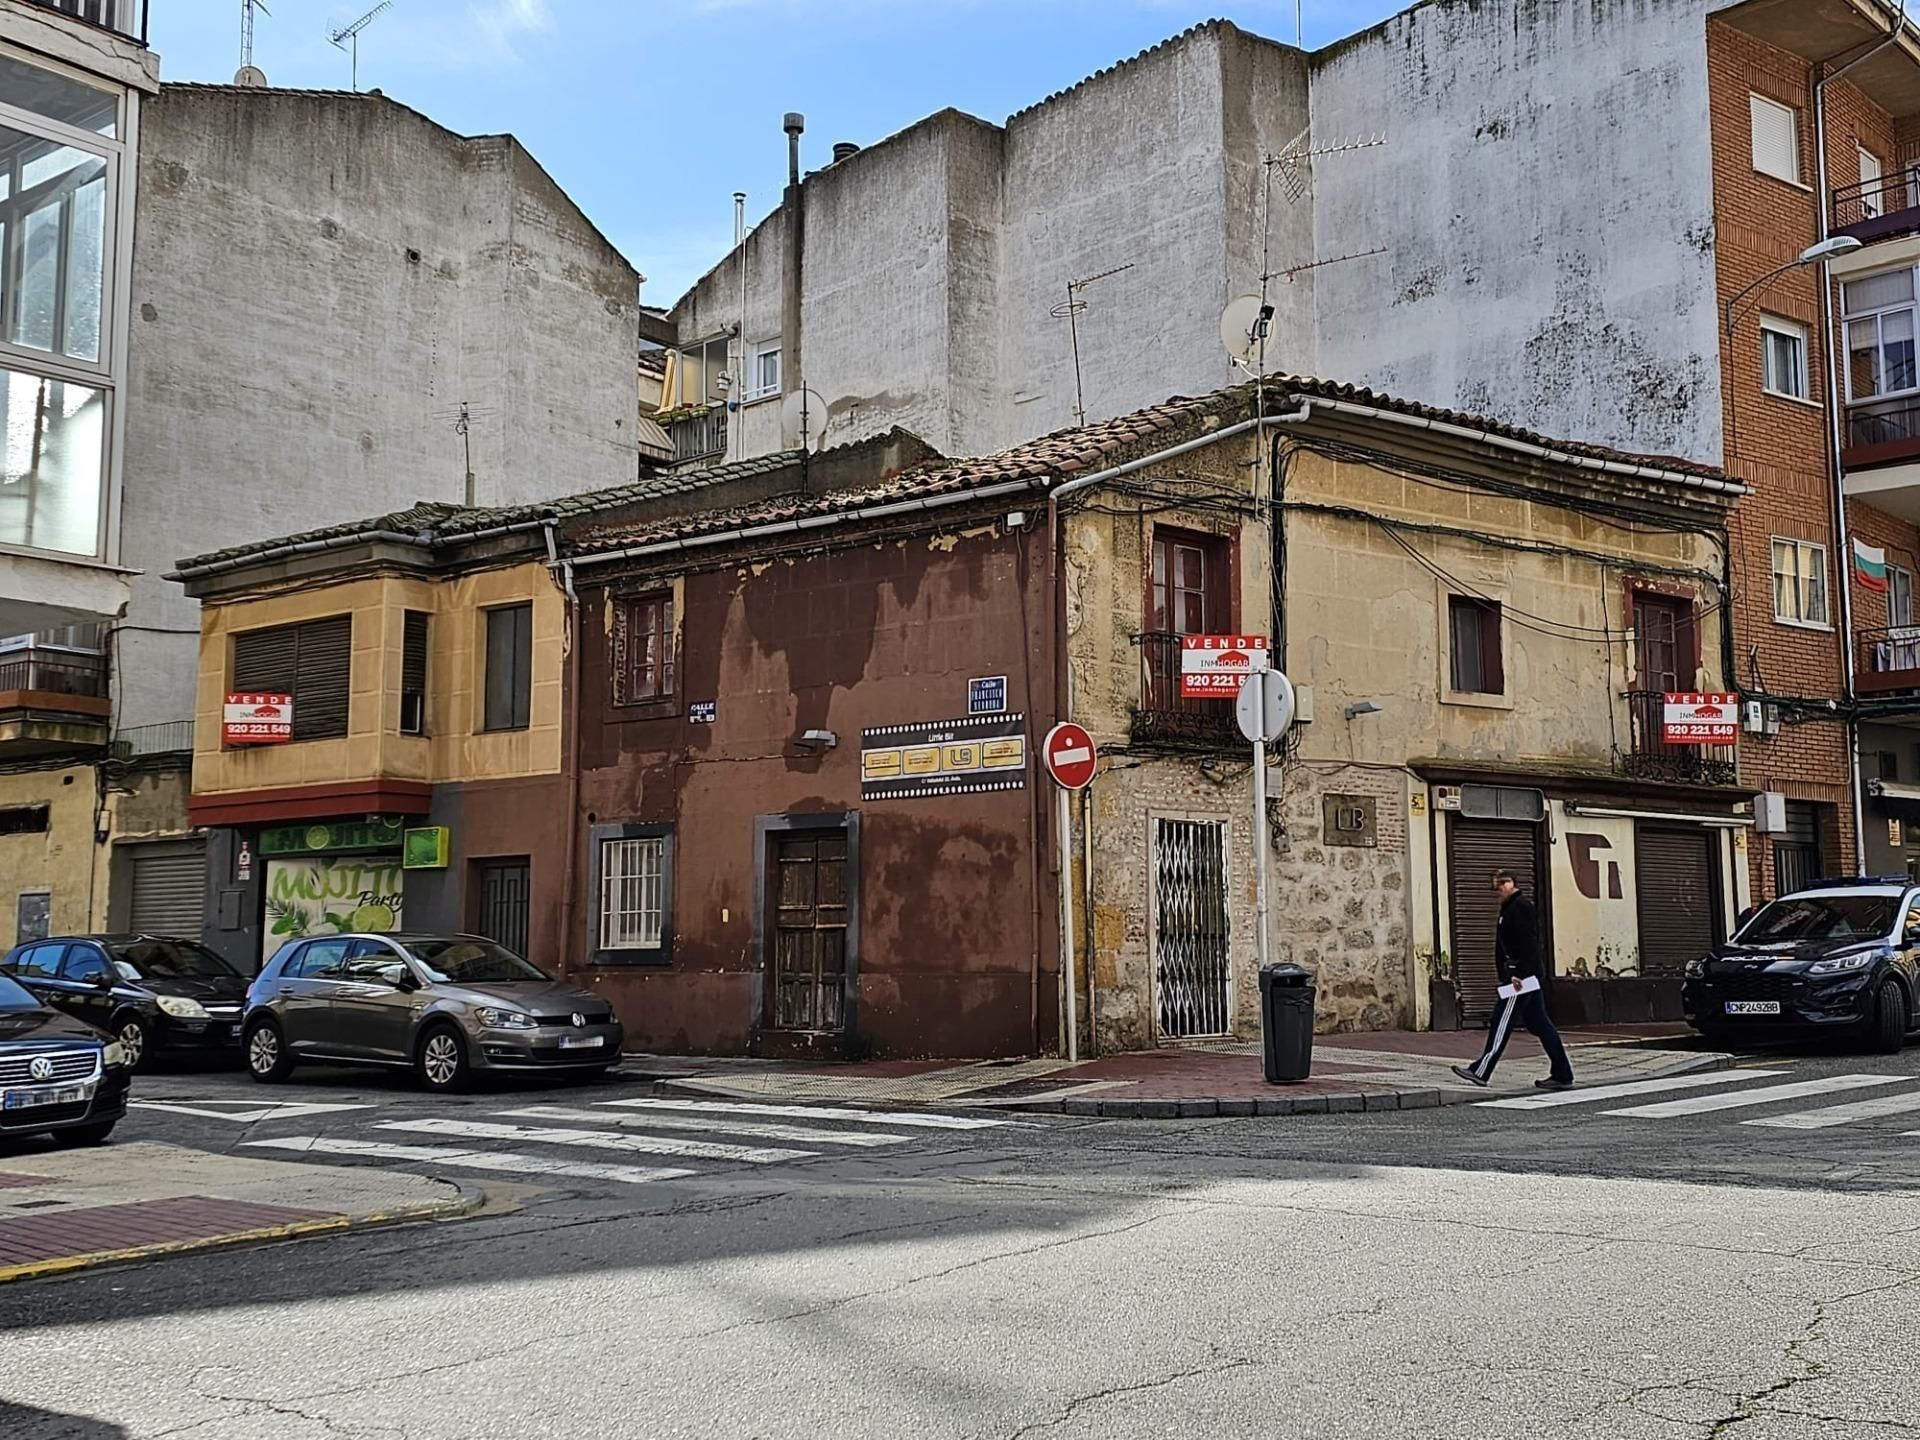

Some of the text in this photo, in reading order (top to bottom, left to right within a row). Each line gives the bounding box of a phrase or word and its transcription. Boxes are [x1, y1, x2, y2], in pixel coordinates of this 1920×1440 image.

[1187, 638, 1263, 649] VENDE
[1186, 675, 1209, 686] 920
[1212, 675, 1236, 686] 221
[228, 695, 292, 704] VENDE
[1668, 695, 1734, 704] VENDE
[690, 703, 715, 711] CALLE
[227, 724, 291, 734] 920 221 549
[1668, 725, 1734, 735] 920 221 549
[358, 890, 403, 913] Party
